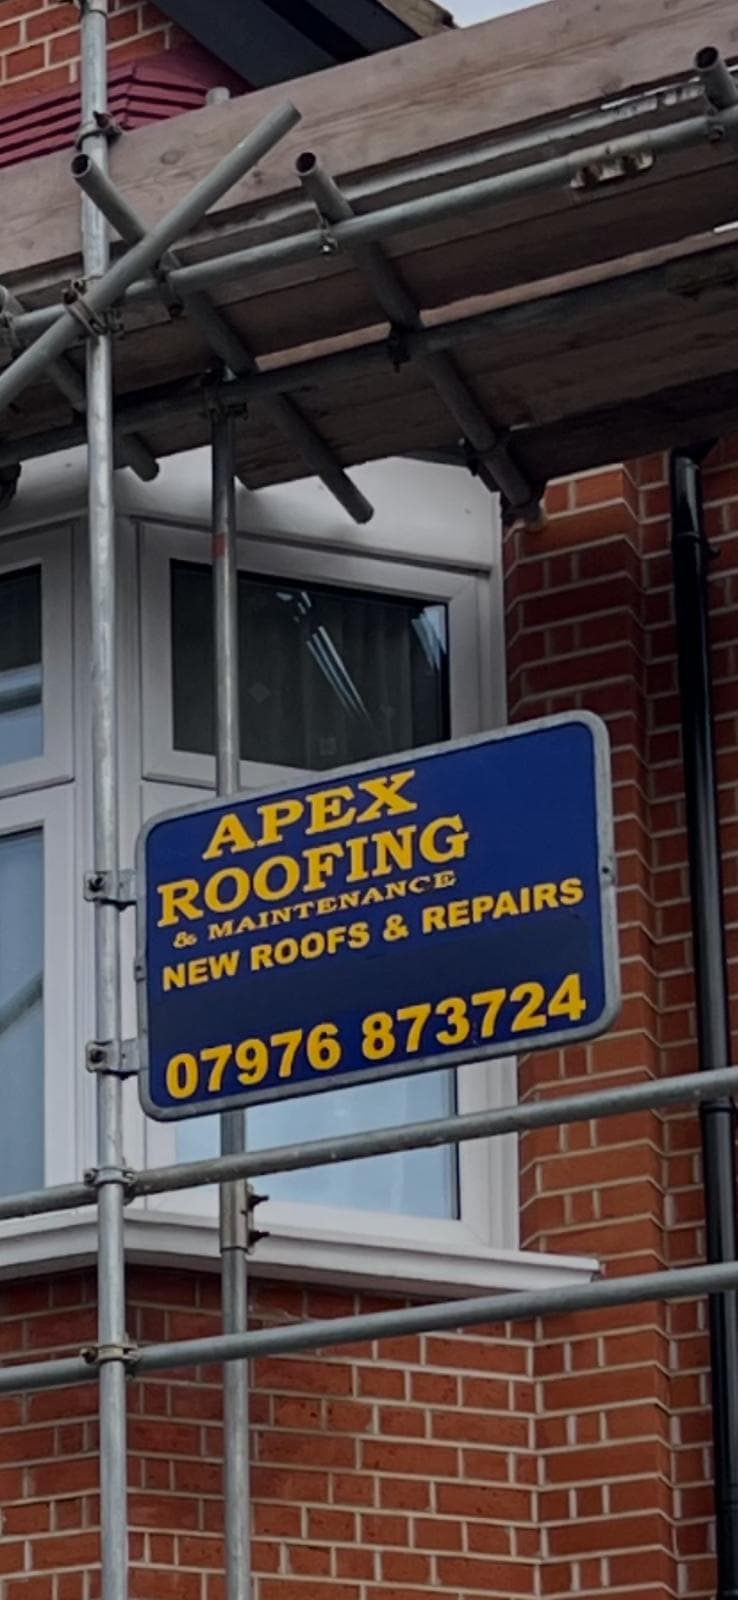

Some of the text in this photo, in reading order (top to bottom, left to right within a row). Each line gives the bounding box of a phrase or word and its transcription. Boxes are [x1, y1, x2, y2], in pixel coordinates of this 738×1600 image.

[157, 815, 469, 927] ROOFING
[202, 770, 417, 860] APEX
[163, 878, 584, 990] NEW ROOFS & REPAIRS
[173, 870, 457, 948] & MAINTENANCE
[166, 973, 587, 1099] 07976 873724
